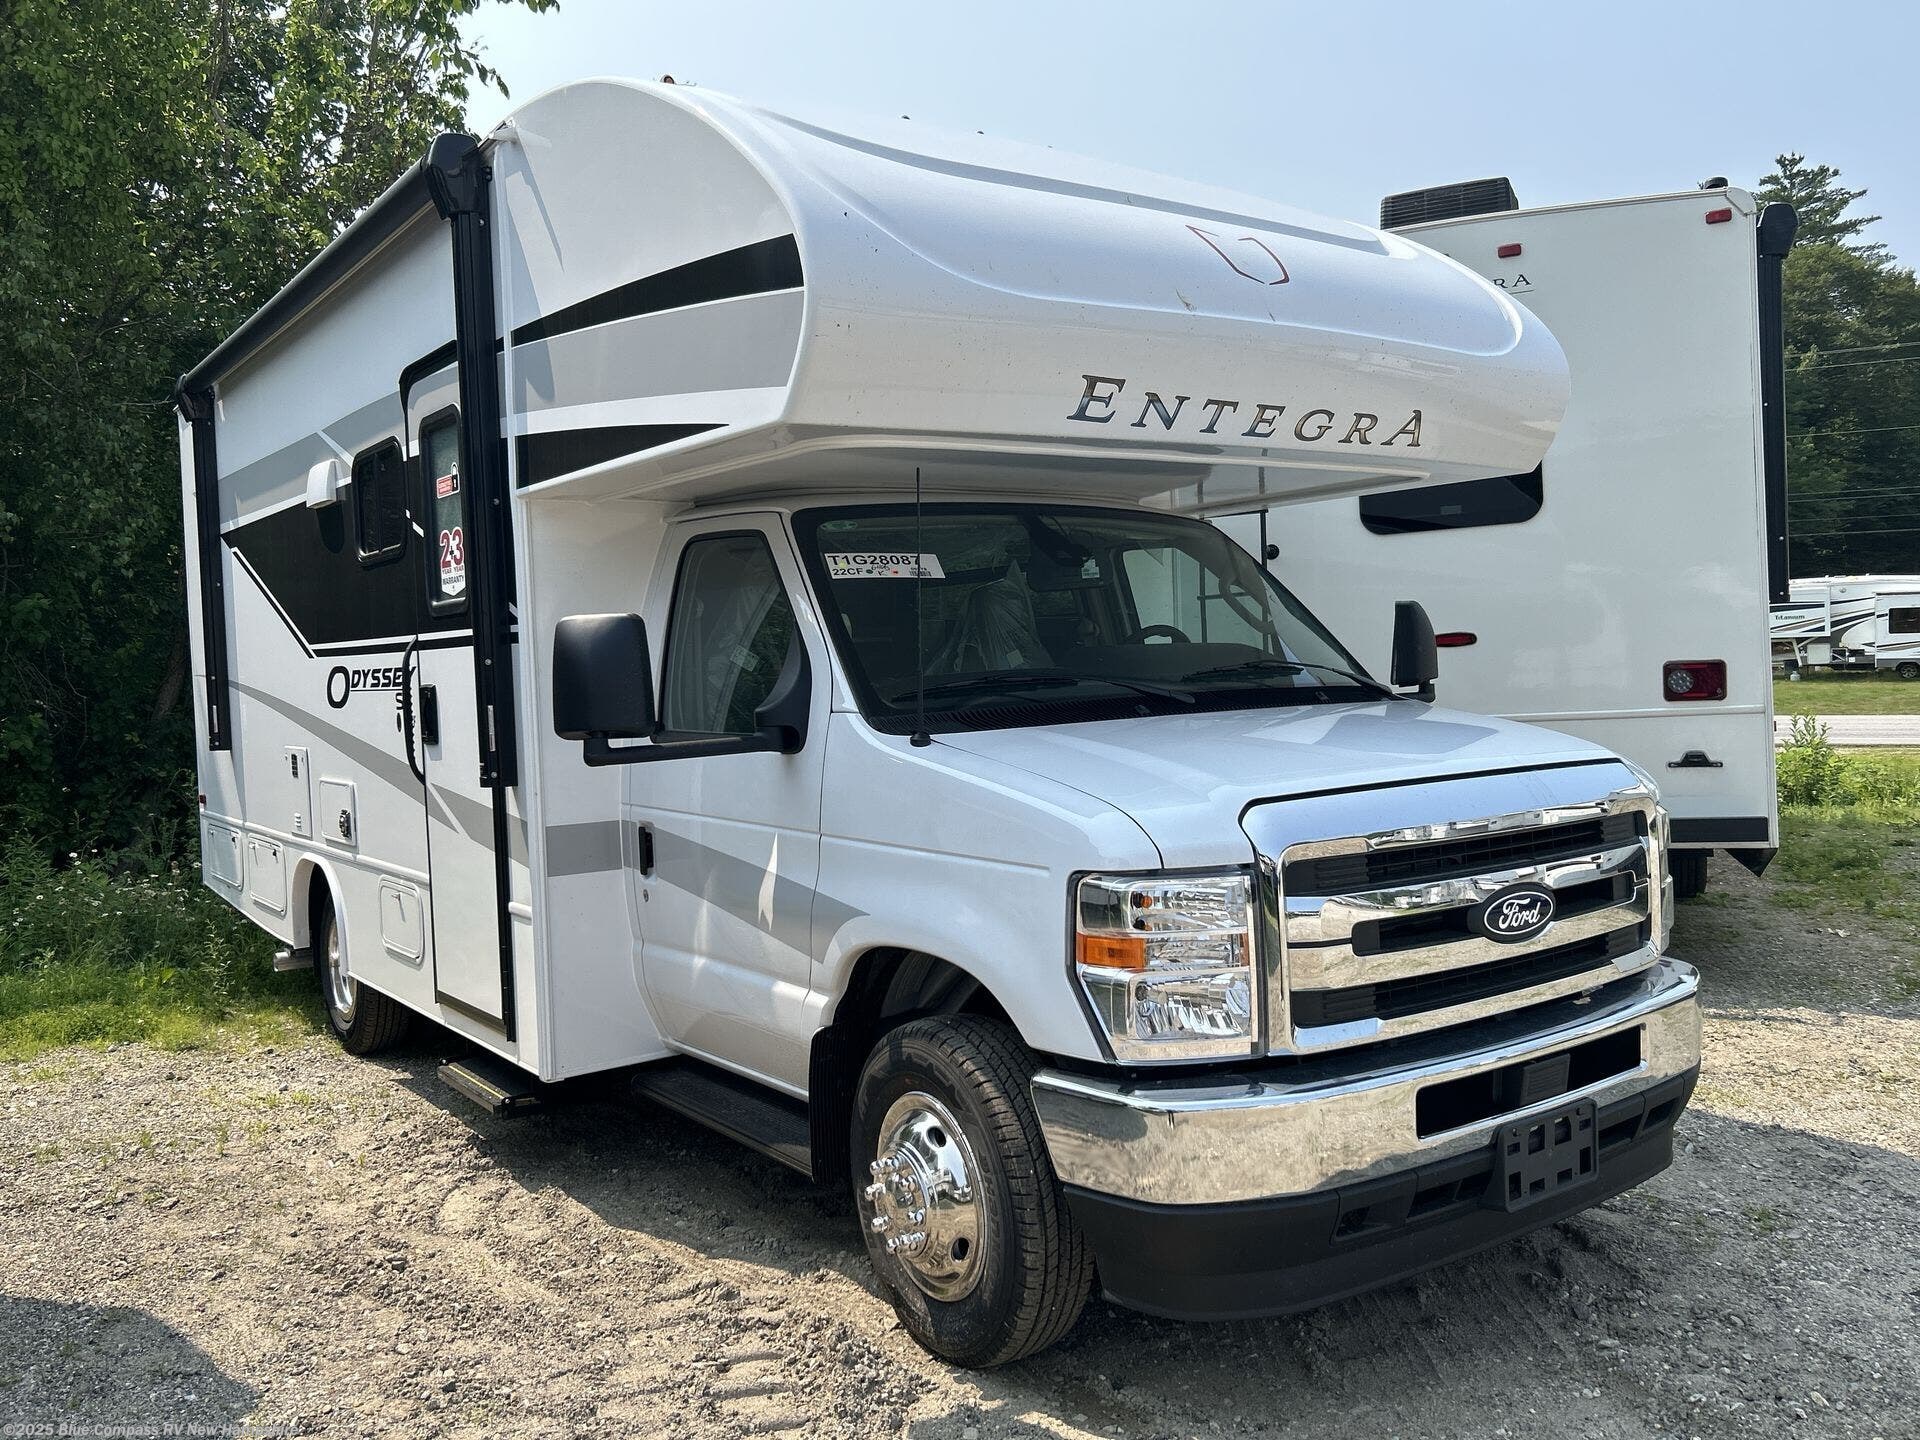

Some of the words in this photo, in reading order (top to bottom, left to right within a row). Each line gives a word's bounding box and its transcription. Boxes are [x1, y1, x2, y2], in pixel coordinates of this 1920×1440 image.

[1066, 374, 1424, 448] ENTEGRA
[832, 568, 863, 576] 22CF
[1498, 897, 1541, 930] Ford
